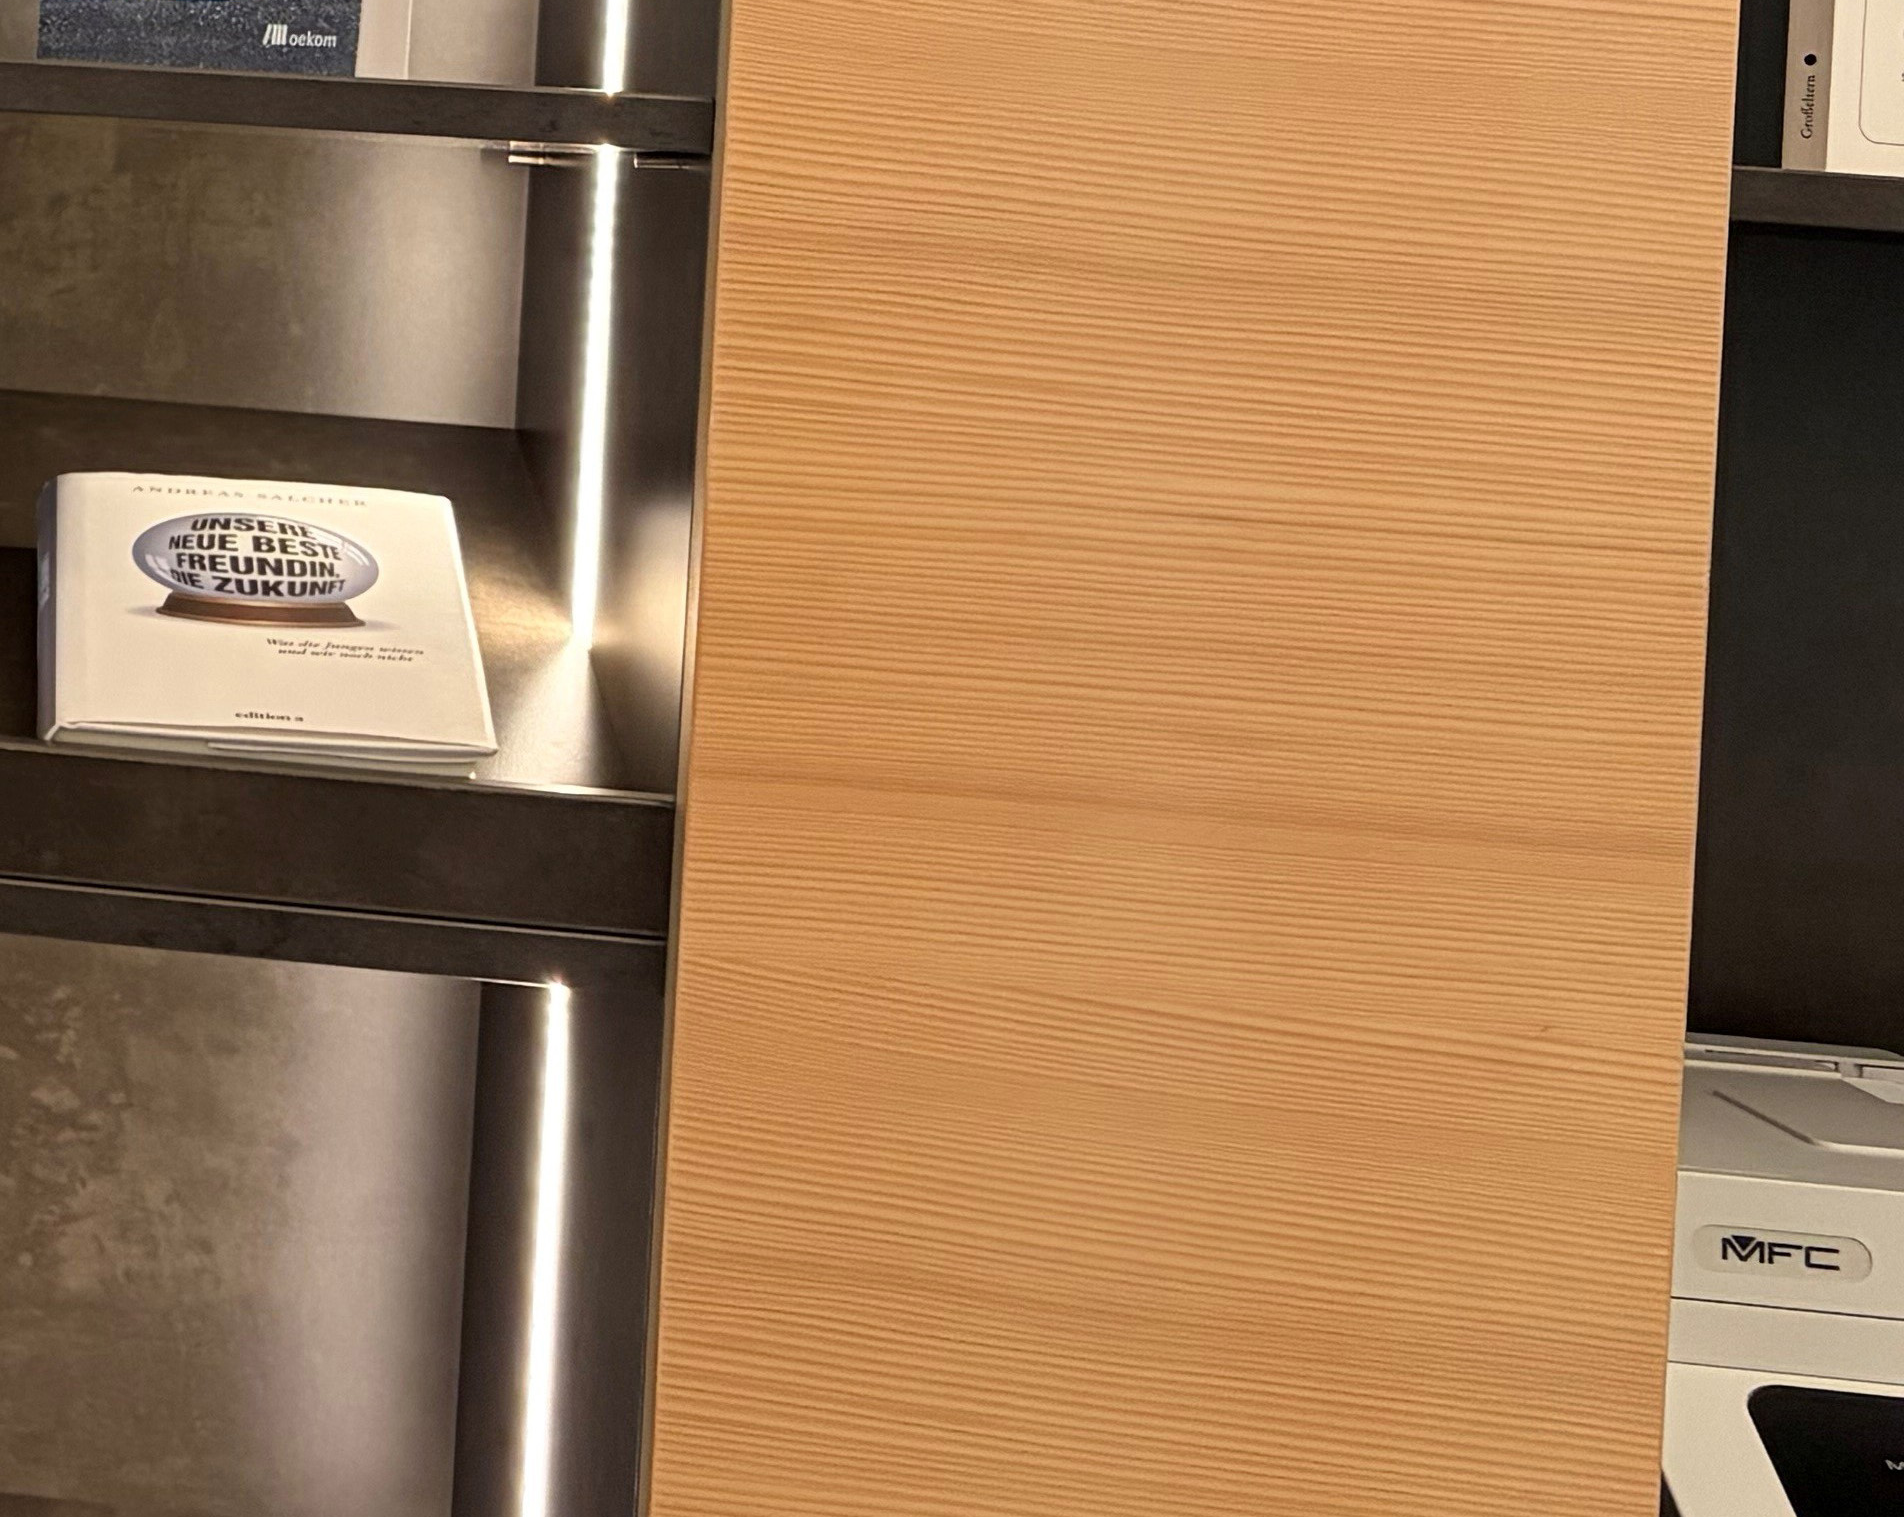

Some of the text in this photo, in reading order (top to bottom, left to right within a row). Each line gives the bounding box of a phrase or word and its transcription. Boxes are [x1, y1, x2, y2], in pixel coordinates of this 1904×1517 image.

[289, 29, 337, 48] oekom
[191, 517, 316, 540] UNSERE
[168, 533, 342, 561] NEUE BESTE
[212, 575, 346, 598] ZUKUNFT
[1721, 1234, 1841, 1271] MFC
